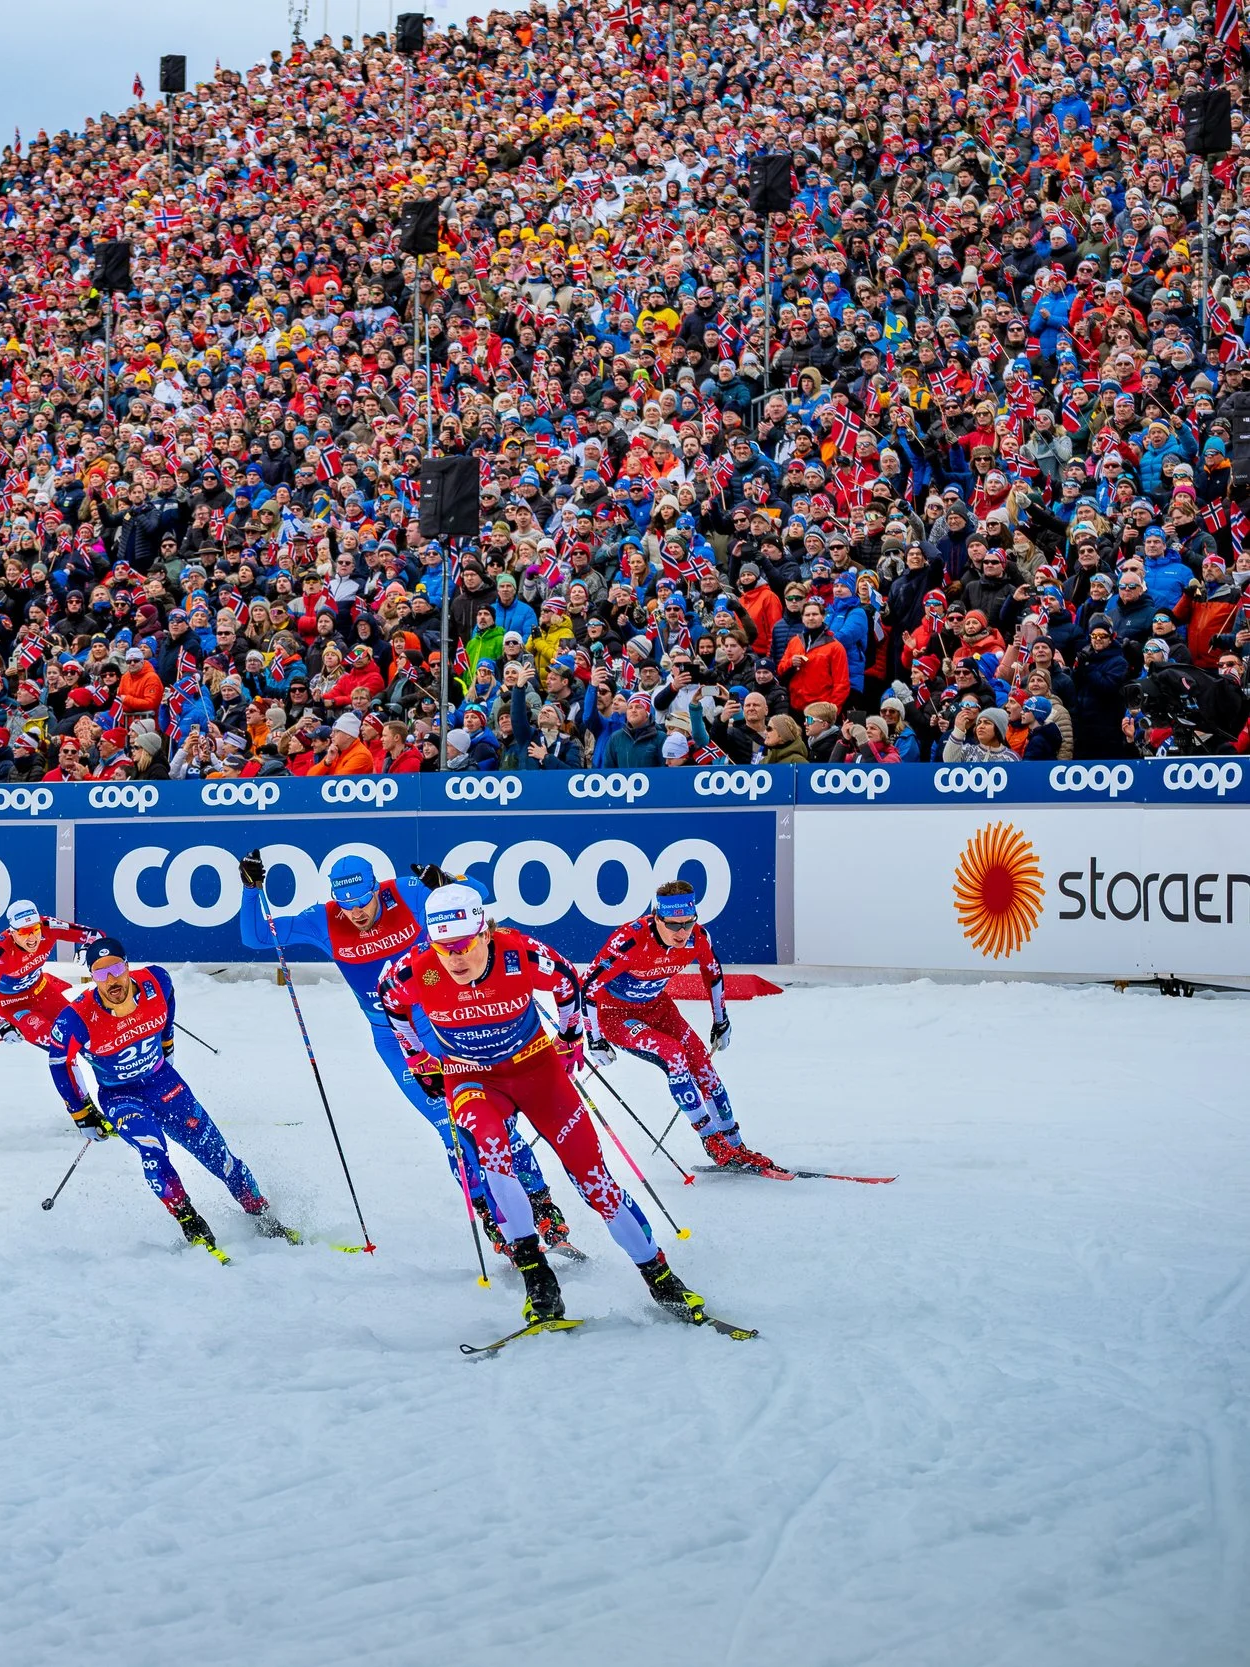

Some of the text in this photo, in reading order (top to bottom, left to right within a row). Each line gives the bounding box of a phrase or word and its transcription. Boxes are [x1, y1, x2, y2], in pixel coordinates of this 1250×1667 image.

[322, 778, 398, 807] coop
[446, 776, 522, 805] coop
[568, 773, 649, 802] coop
[694, 770, 772, 800] coop
[811, 769, 890, 799] coop
[934, 767, 1007, 798] coop
[1050, 765, 1133, 797] coop
[1164, 763, 1242, 795] coop
[89, 785, 158, 812] coop
[202, 782, 280, 810] coop
[355, 923, 416, 957] GENERALI
[607, 946, 626, 958] CRAFT
[647, 965, 685, 977] GENERA
[118, 1036, 156, 1064] 25
[676, 1091, 696, 1106] 10
[530, 1156, 538, 1171] 4
